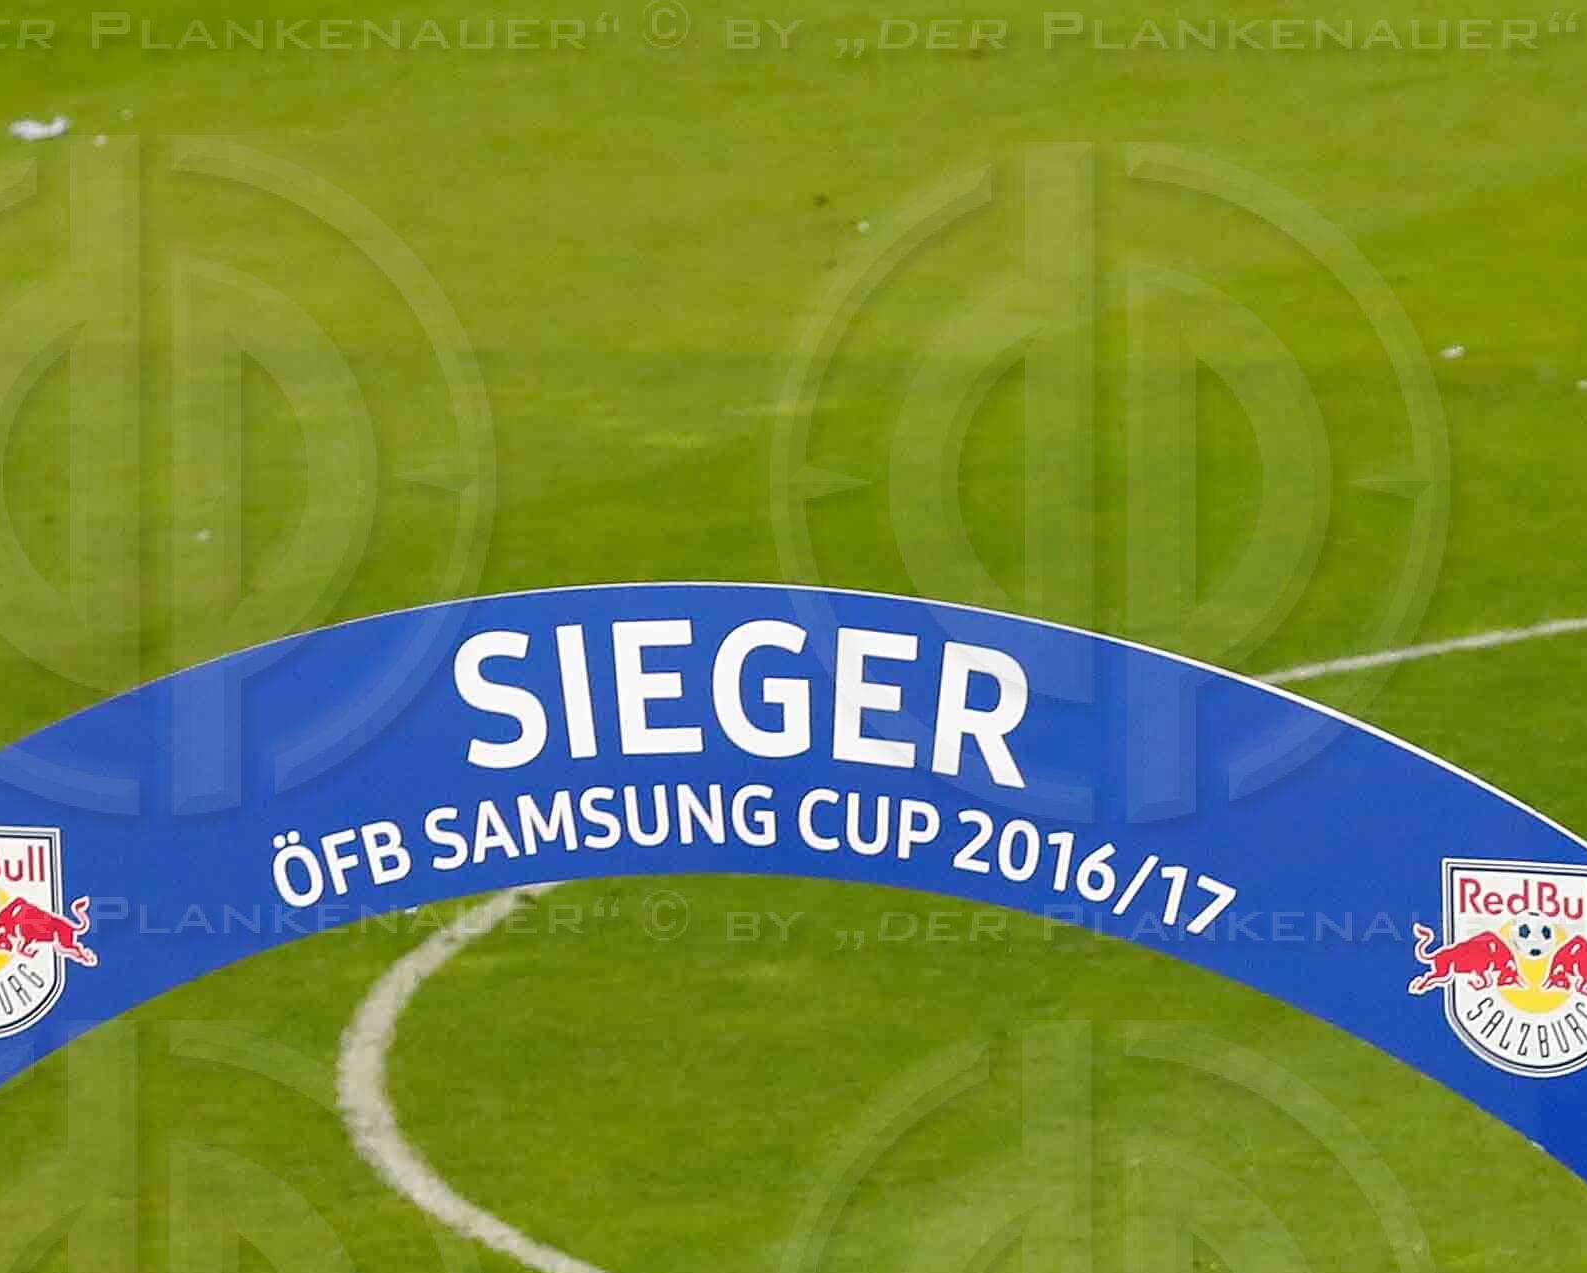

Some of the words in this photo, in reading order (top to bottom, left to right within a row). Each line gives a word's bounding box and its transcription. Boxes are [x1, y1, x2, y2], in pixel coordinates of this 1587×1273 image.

[453, 618, 1028, 789] SIEGER
[271, 809, 412, 909] ÖFB
[422, 784, 778, 872] SAMSUNG
[797, 789, 941, 860] CUP
[953, 810, 1238, 936] 2016/17
